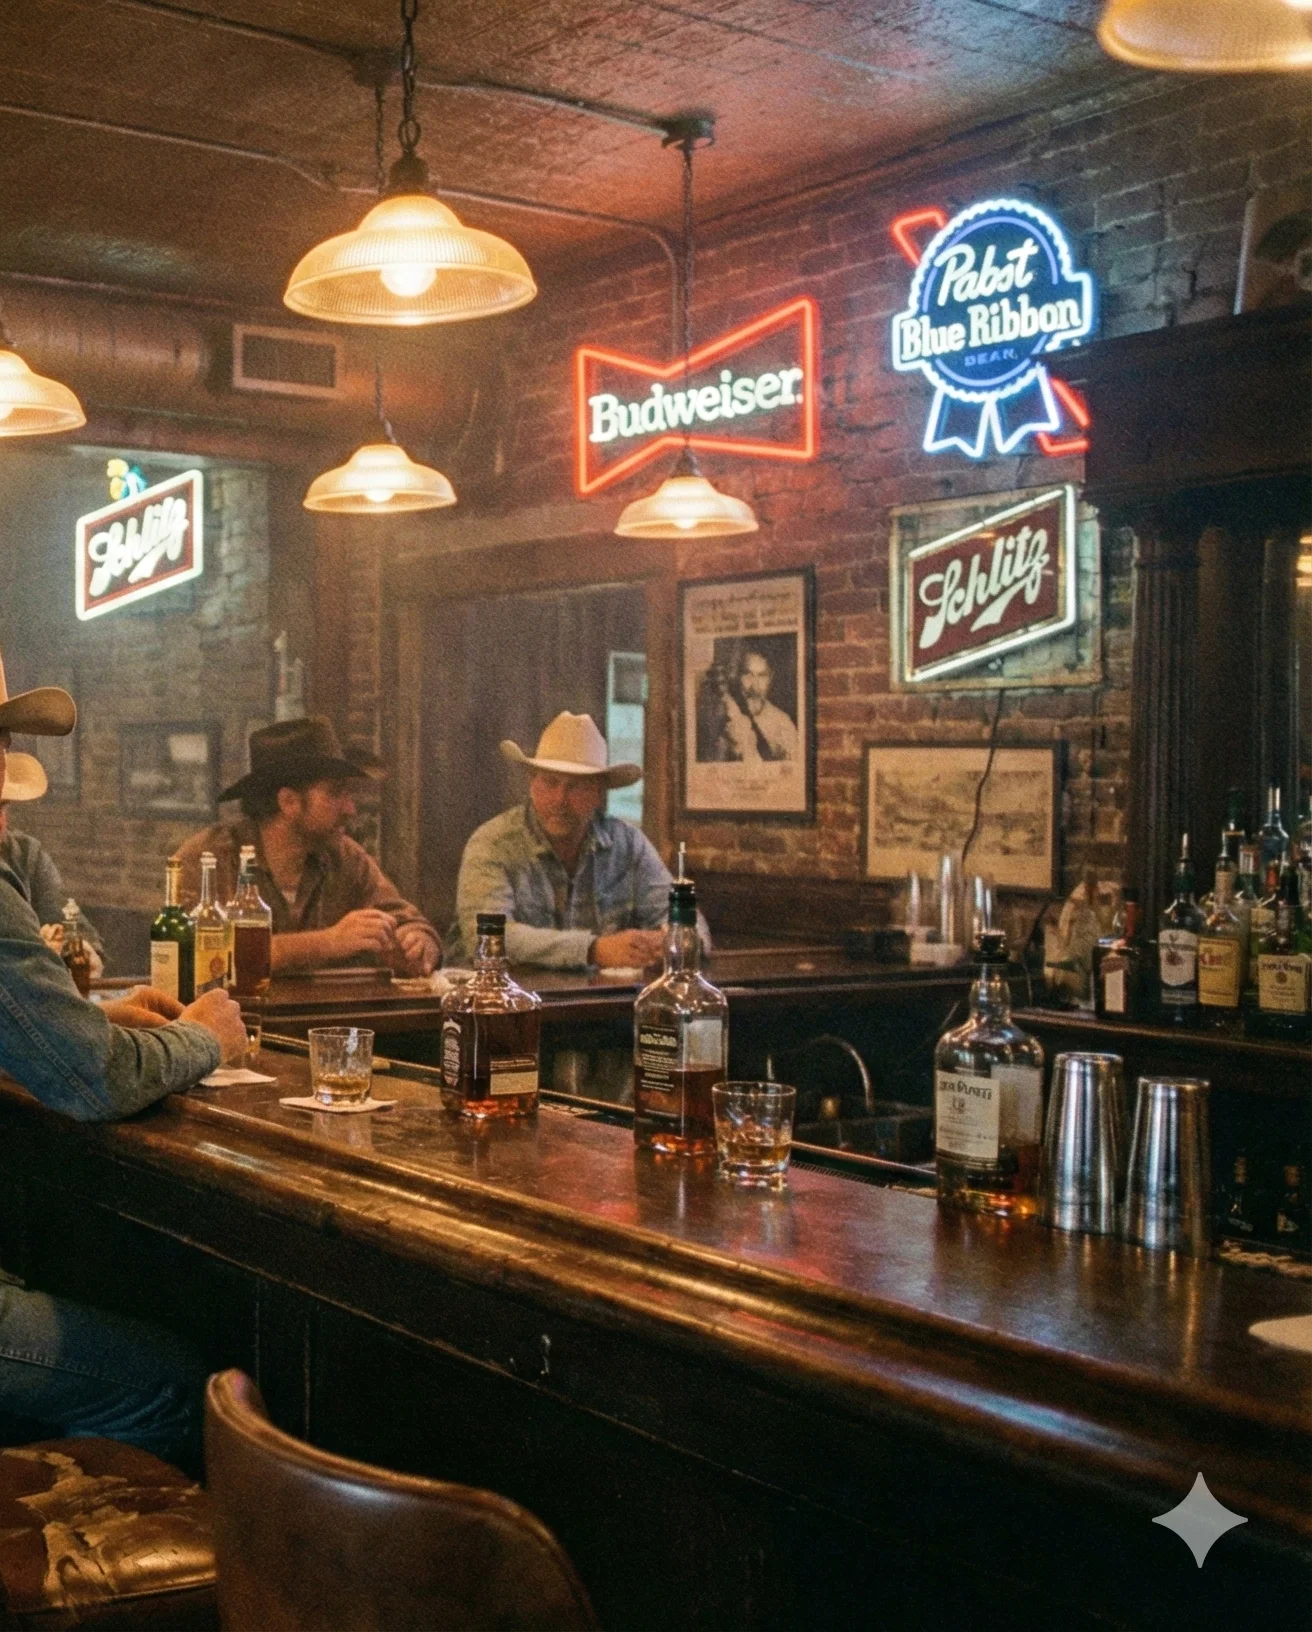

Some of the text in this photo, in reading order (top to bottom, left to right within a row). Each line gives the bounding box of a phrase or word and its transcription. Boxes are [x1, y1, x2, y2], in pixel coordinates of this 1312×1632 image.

[934, 238, 1038, 306] Pabst
[901, 293, 1082, 361] Blue Ribbon
[919, 525, 1050, 649] Schlitz
